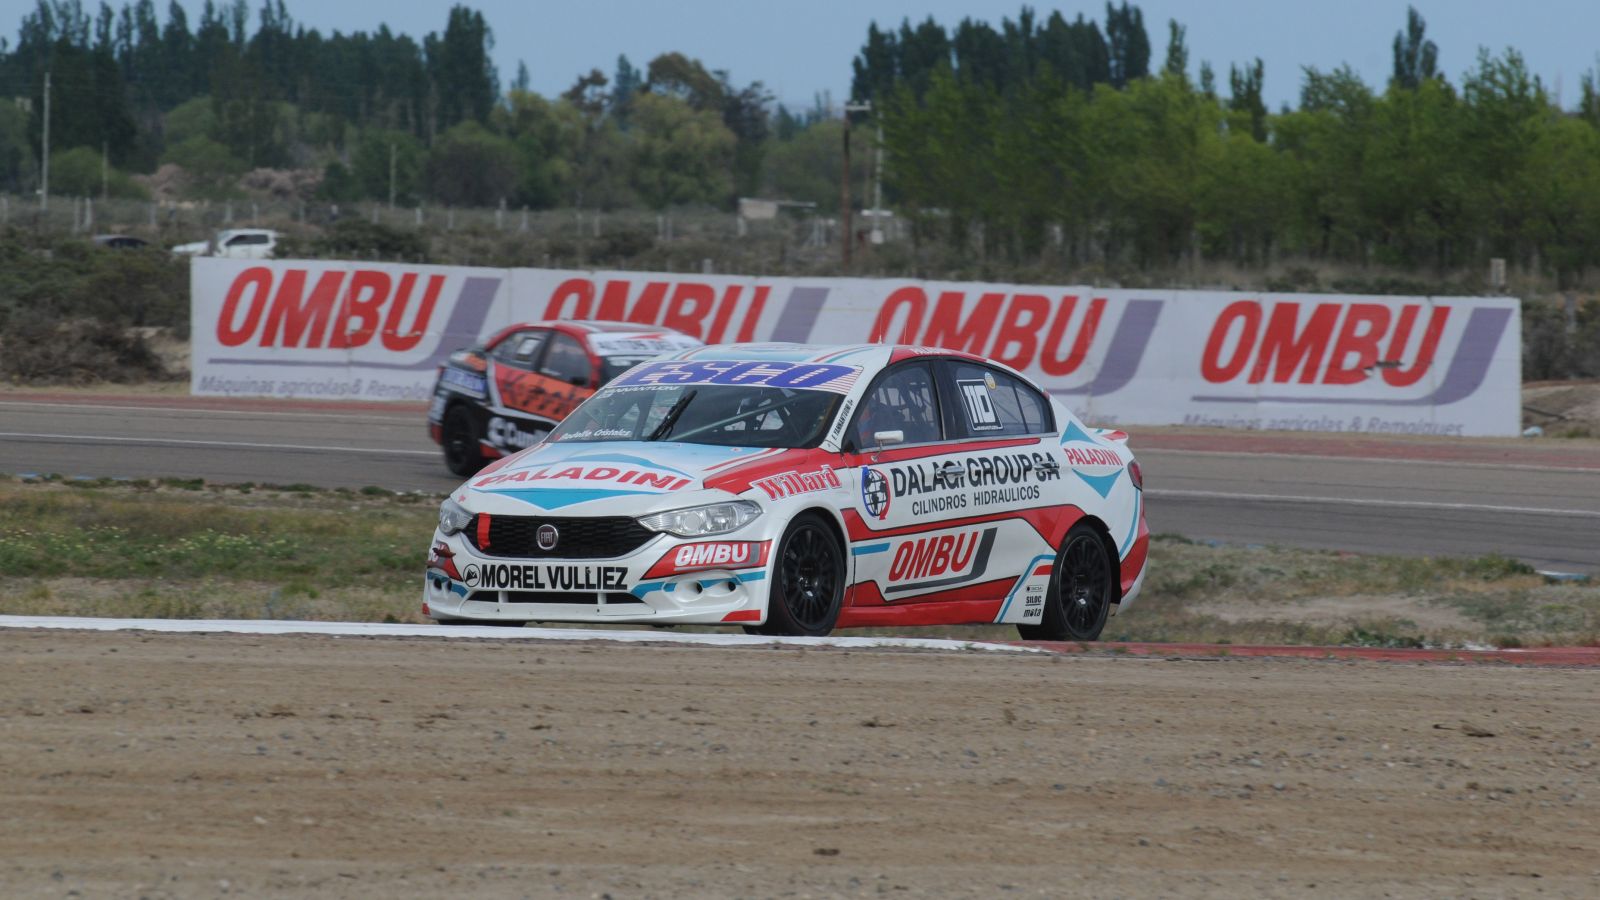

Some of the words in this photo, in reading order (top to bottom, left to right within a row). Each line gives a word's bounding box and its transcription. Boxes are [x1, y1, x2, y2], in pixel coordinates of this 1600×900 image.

[216, 266, 446, 352] OMBU
[867, 286, 1108, 376] OMBU
[1200, 300, 1451, 387] OMBU
[615, 360, 856, 388] ESCO
[962, 385, 996, 423] 110
[1064, 447, 1123, 467] PALADINI
[474, 467, 695, 491] PALADINI
[751, 465, 842, 501] Willard
[912, 493, 967, 515] CILINDROS
[974, 485, 1040, 506] HIDRAULICOS
[540, 531, 554, 543] FIAT
[674, 543, 748, 567] OMBU
[888, 531, 979, 582] OMBU
[481, 564, 546, 589] MOREL
[548, 566, 628, 590] VULLIEZ
